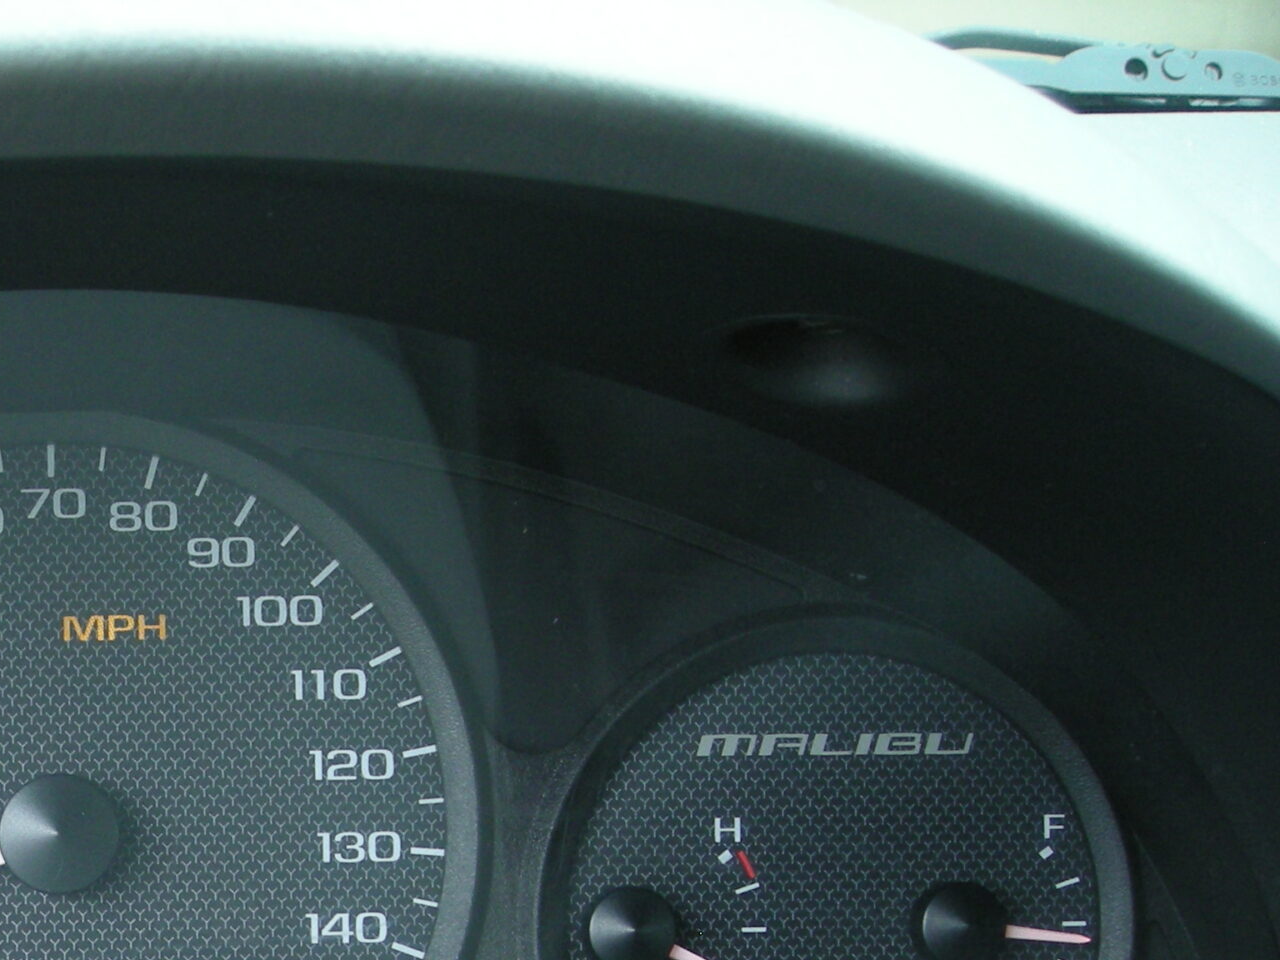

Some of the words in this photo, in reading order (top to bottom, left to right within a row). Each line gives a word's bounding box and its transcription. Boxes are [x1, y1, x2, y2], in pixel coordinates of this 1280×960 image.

[20, 488, 86, 519] 70
[108, 500, 178, 532] 80
[187, 537, 255, 568] 90
[236, 595, 323, 627] 100
[60, 615, 167, 641] MPH
[290, 669, 367, 700] 110
[696, 731, 974, 758] MALIBU
[308, 749, 395, 781] 120
[714, 816, 742, 843] H
[1043, 813, 1066, 839] F
[317, 831, 401, 863] 130
[305, 912, 387, 944] 140
